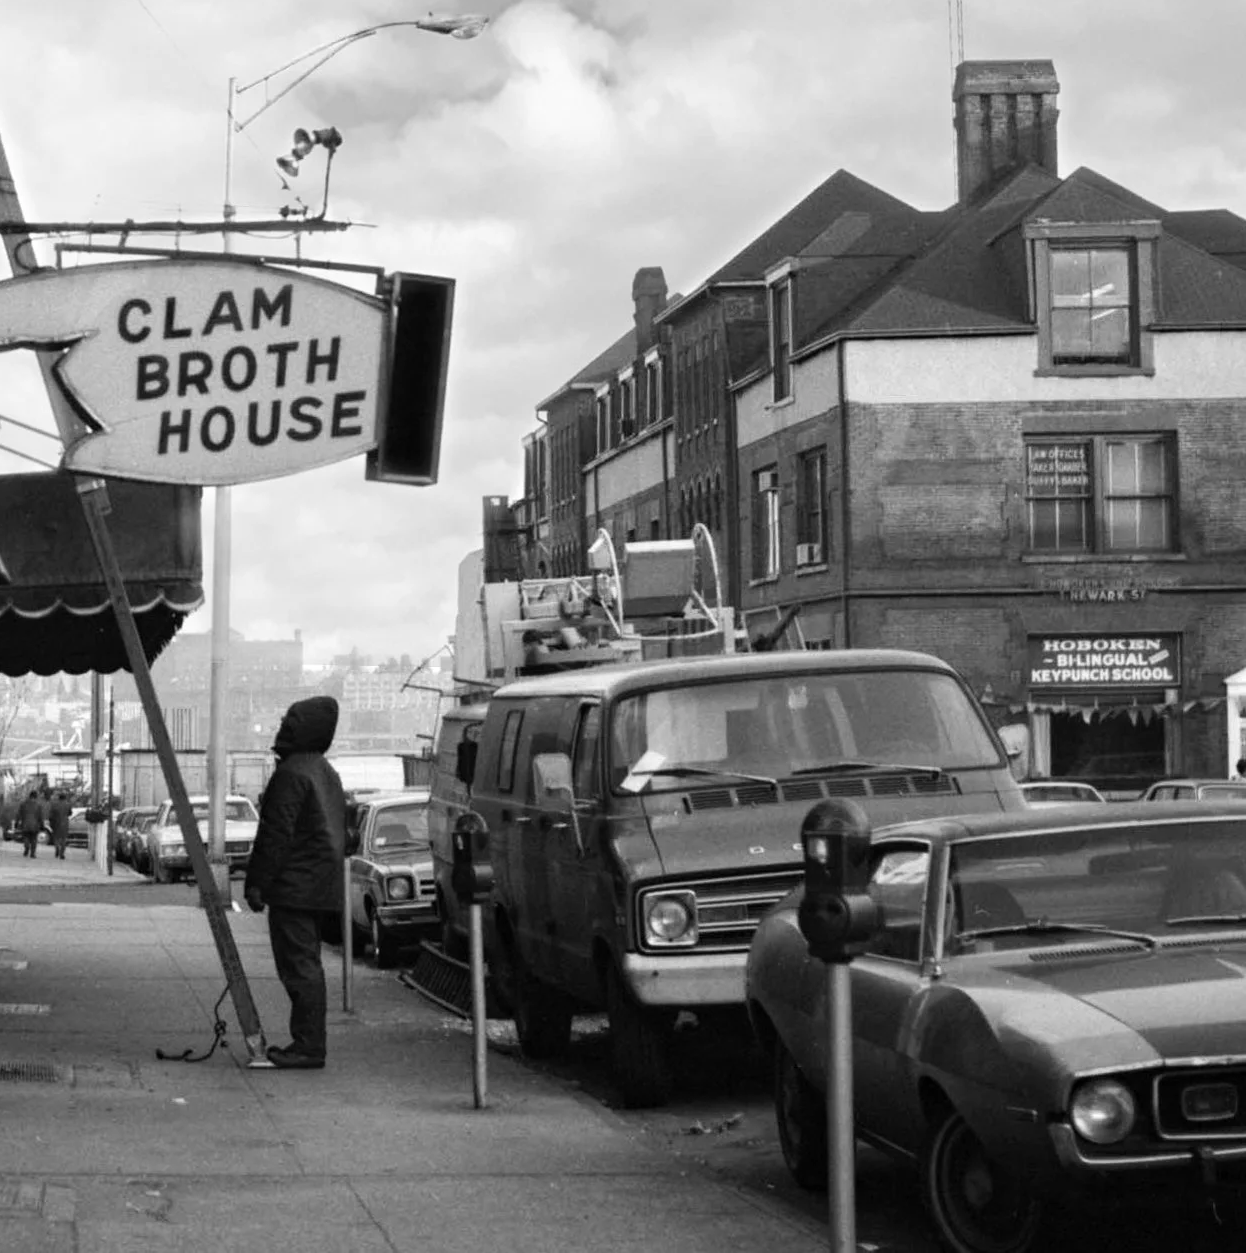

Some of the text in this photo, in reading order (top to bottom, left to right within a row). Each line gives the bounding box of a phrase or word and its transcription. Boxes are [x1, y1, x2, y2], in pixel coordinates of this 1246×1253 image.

[117, 283, 294, 344] CLAM
[136, 335, 342, 401] BROTH
[156, 390, 367, 455] HOUSE
[1048, 448, 1086, 459] OFICES
[1070, 589, 1124, 602] NEWARK
[1042, 638, 1162, 652] HOBOKEN
[1031, 666, 1174, 683] KEYPUNCH SCHOOL
